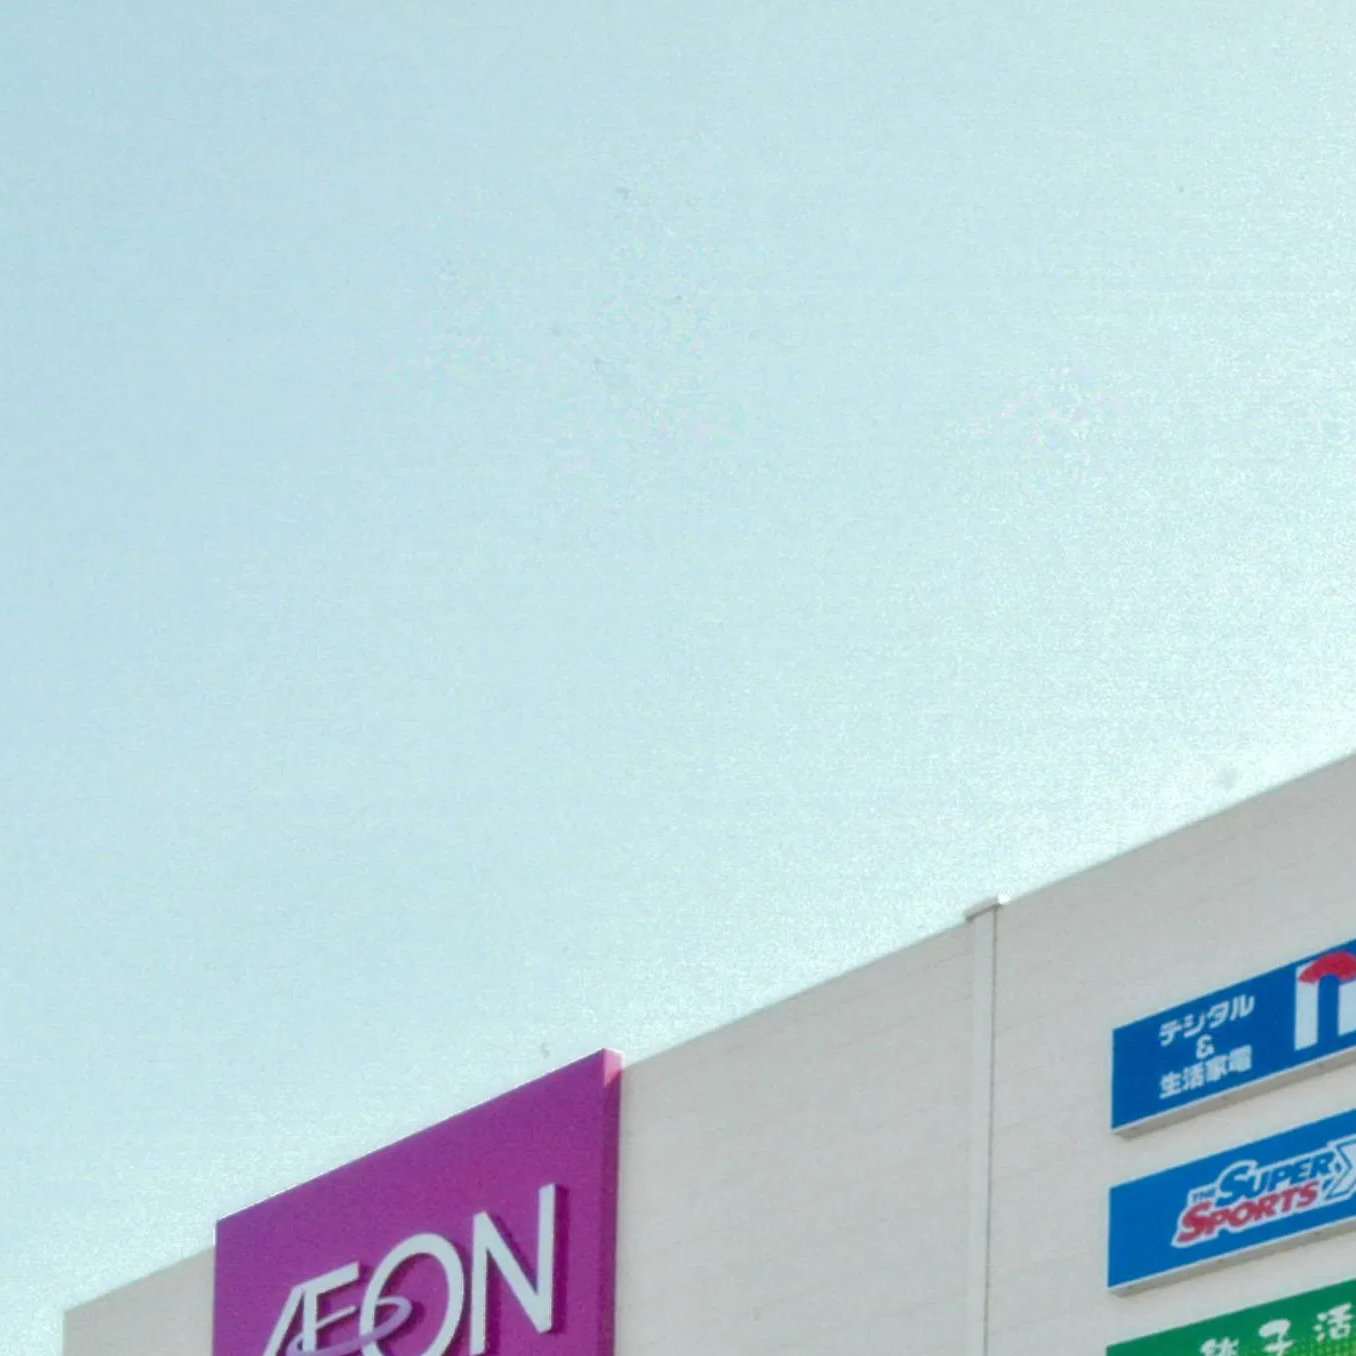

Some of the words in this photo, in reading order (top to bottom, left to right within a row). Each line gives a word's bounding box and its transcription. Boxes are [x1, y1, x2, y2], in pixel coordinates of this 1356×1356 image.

[1159, 1044, 1253, 1099] 生活家電
[1195, 1033, 1216, 1060] &
[1174, 1178, 1321, 1246] SPORTS
